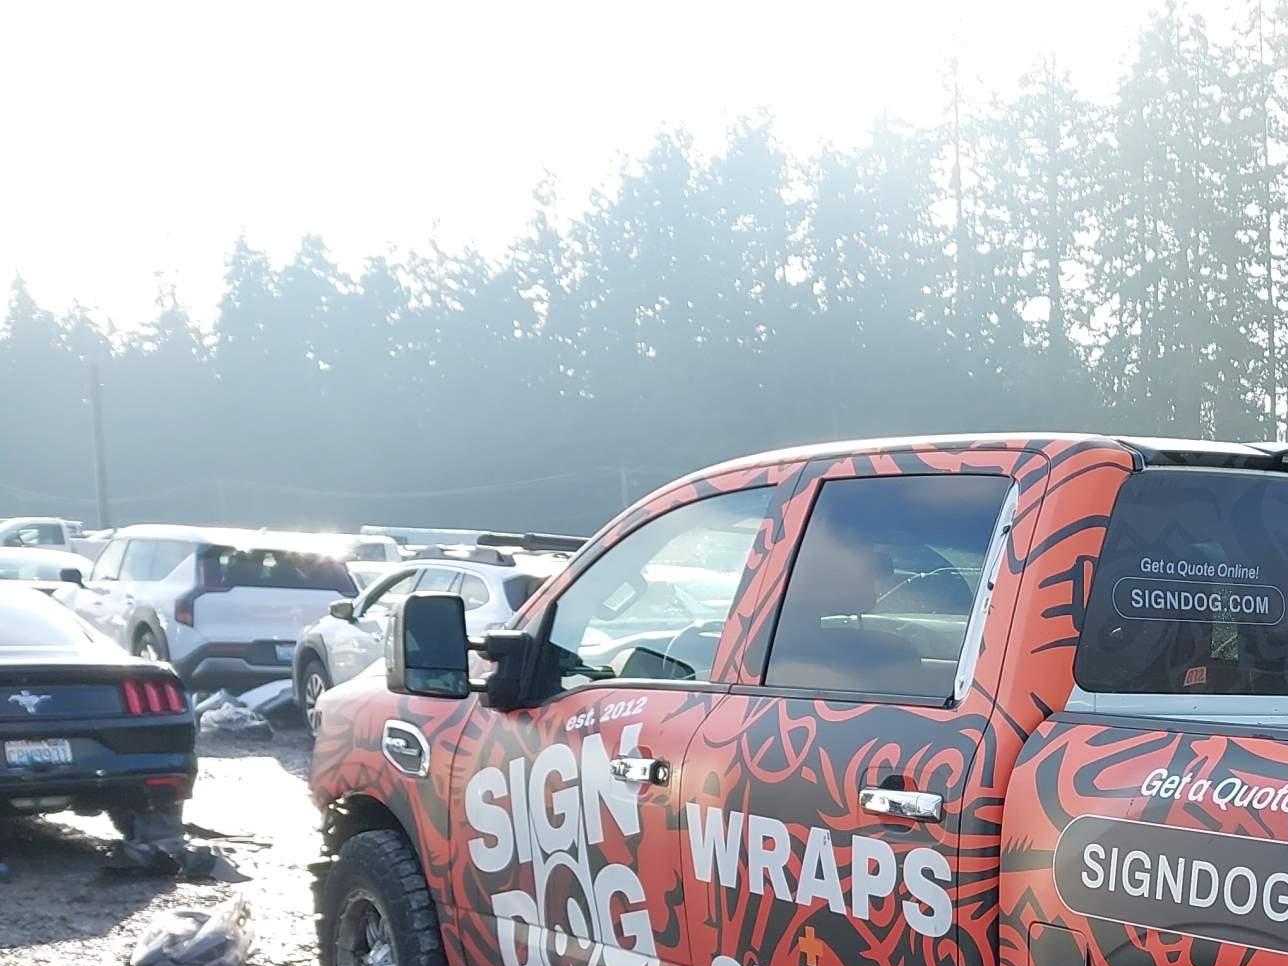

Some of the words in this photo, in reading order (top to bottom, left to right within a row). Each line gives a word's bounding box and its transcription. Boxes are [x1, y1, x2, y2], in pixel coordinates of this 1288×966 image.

[1140, 557, 1164, 573] Get
[1166, 562, 1175, 574] a
[1177, 560, 1215, 577] Quote
[1217, 562, 1260, 580] Online!
[1131, 588, 1269, 615] SIGNDOG.COM
[566, 709, 595, 732] est.
[600, 697, 648, 723] 2012
[465, 722, 643, 873] SIGN
[1140, 768, 1191, 800] Get
[1189, 778, 1210, 803] a
[686, 803, 953, 938] WRAPS
